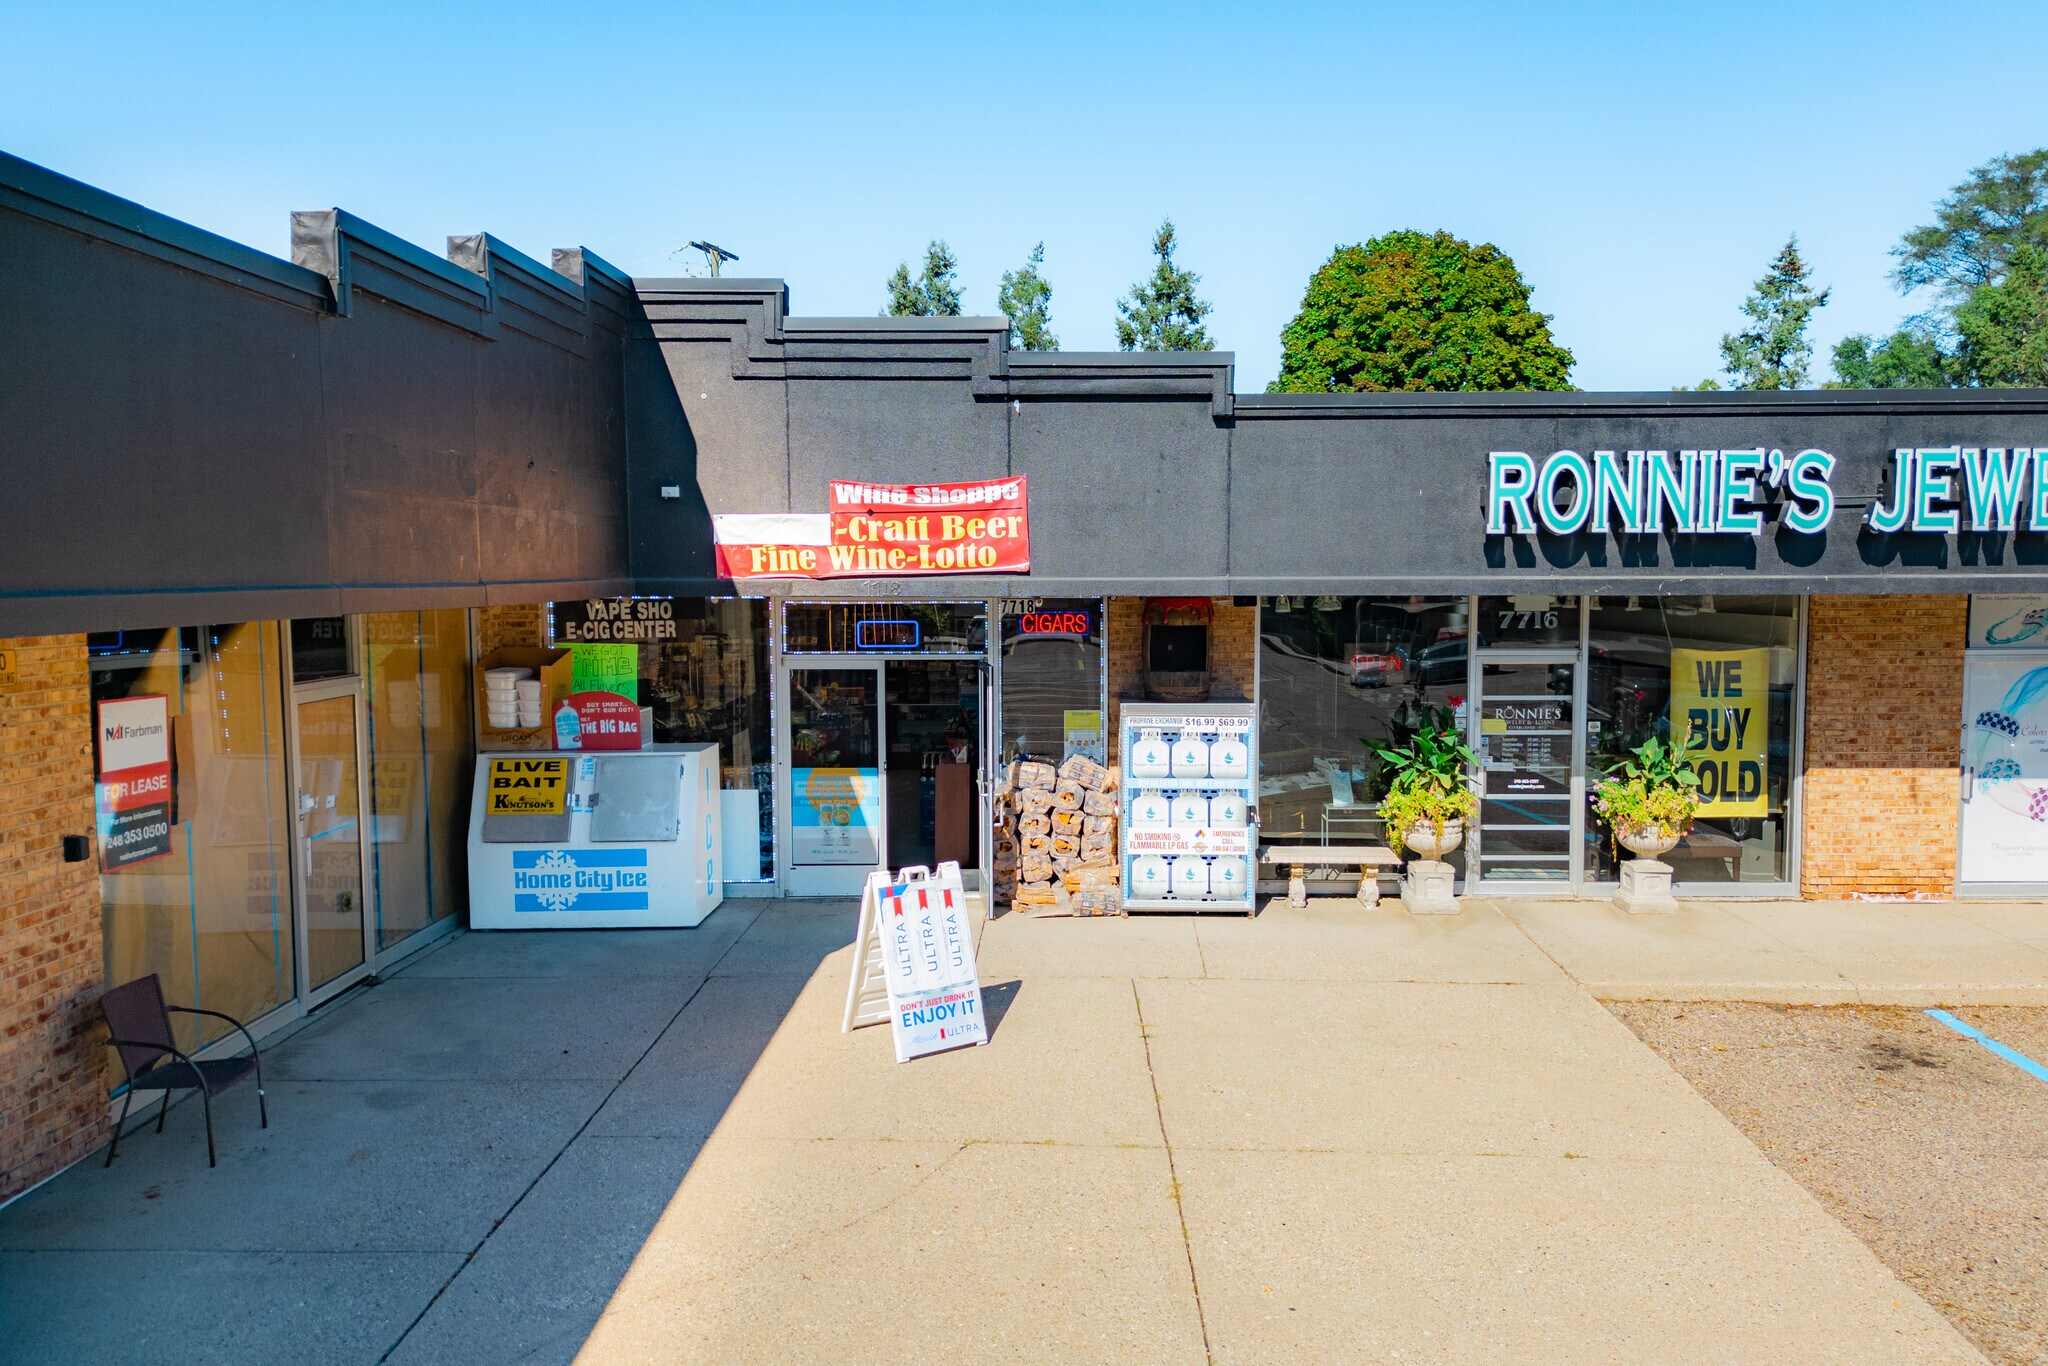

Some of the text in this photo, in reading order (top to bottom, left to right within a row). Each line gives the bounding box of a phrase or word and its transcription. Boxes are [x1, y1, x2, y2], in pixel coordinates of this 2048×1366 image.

[834, 482, 1019, 504] Wine Shoppe
[1487, 446, 1836, 535] RONNIE'S
[941, 515, 1023, 541] Beer
[750, 542, 997, 573] Fine Wine-Lotto
[586, 601, 673, 620] VAPE SHO
[1001, 599, 1035, 614] 7718
[566, 620, 677, 639] E-CIG CENTER
[1022, 613, 1087, 634] CIGARS
[1498, 611, 1559, 629] 7716
[581, 645, 625, 656] WE GOT
[1351, 655, 1403, 671] OPEN
[1696, 660, 1743, 698] WE
[1185, 718, 1215, 727] $16.99
[1218, 718, 1249, 727] $69.99
[1495, 705, 1562, 720] RONNIE'S
[105, 723, 163, 741] NAI Farbman
[580, 719, 638, 734] THE BIG BAG
[1685, 707, 1751, 752] BUY
[496, 761, 561, 772] LIVE
[104, 774, 168, 801] FOR LEASE
[493, 777, 561, 788] BAIT
[107, 822, 168, 849] 248 353 0500
[1134, 833, 1172, 841] NO SMOKING
[1129, 842, 1166, 850] FLAMMABLE
[1177, 842, 1189, 850] GAS
[514, 870, 647, 891] Home City Ice
[896, 921, 913, 977] ULTRA
[921, 915, 938, 972] ULTRA
[946, 914, 963, 967] ULTRA
[900, 990, 974, 1012] DON'T JUST DRINK IT
[902, 999, 975, 1028] ENJOY IT
[947, 1023, 979, 1037] ULTRA
